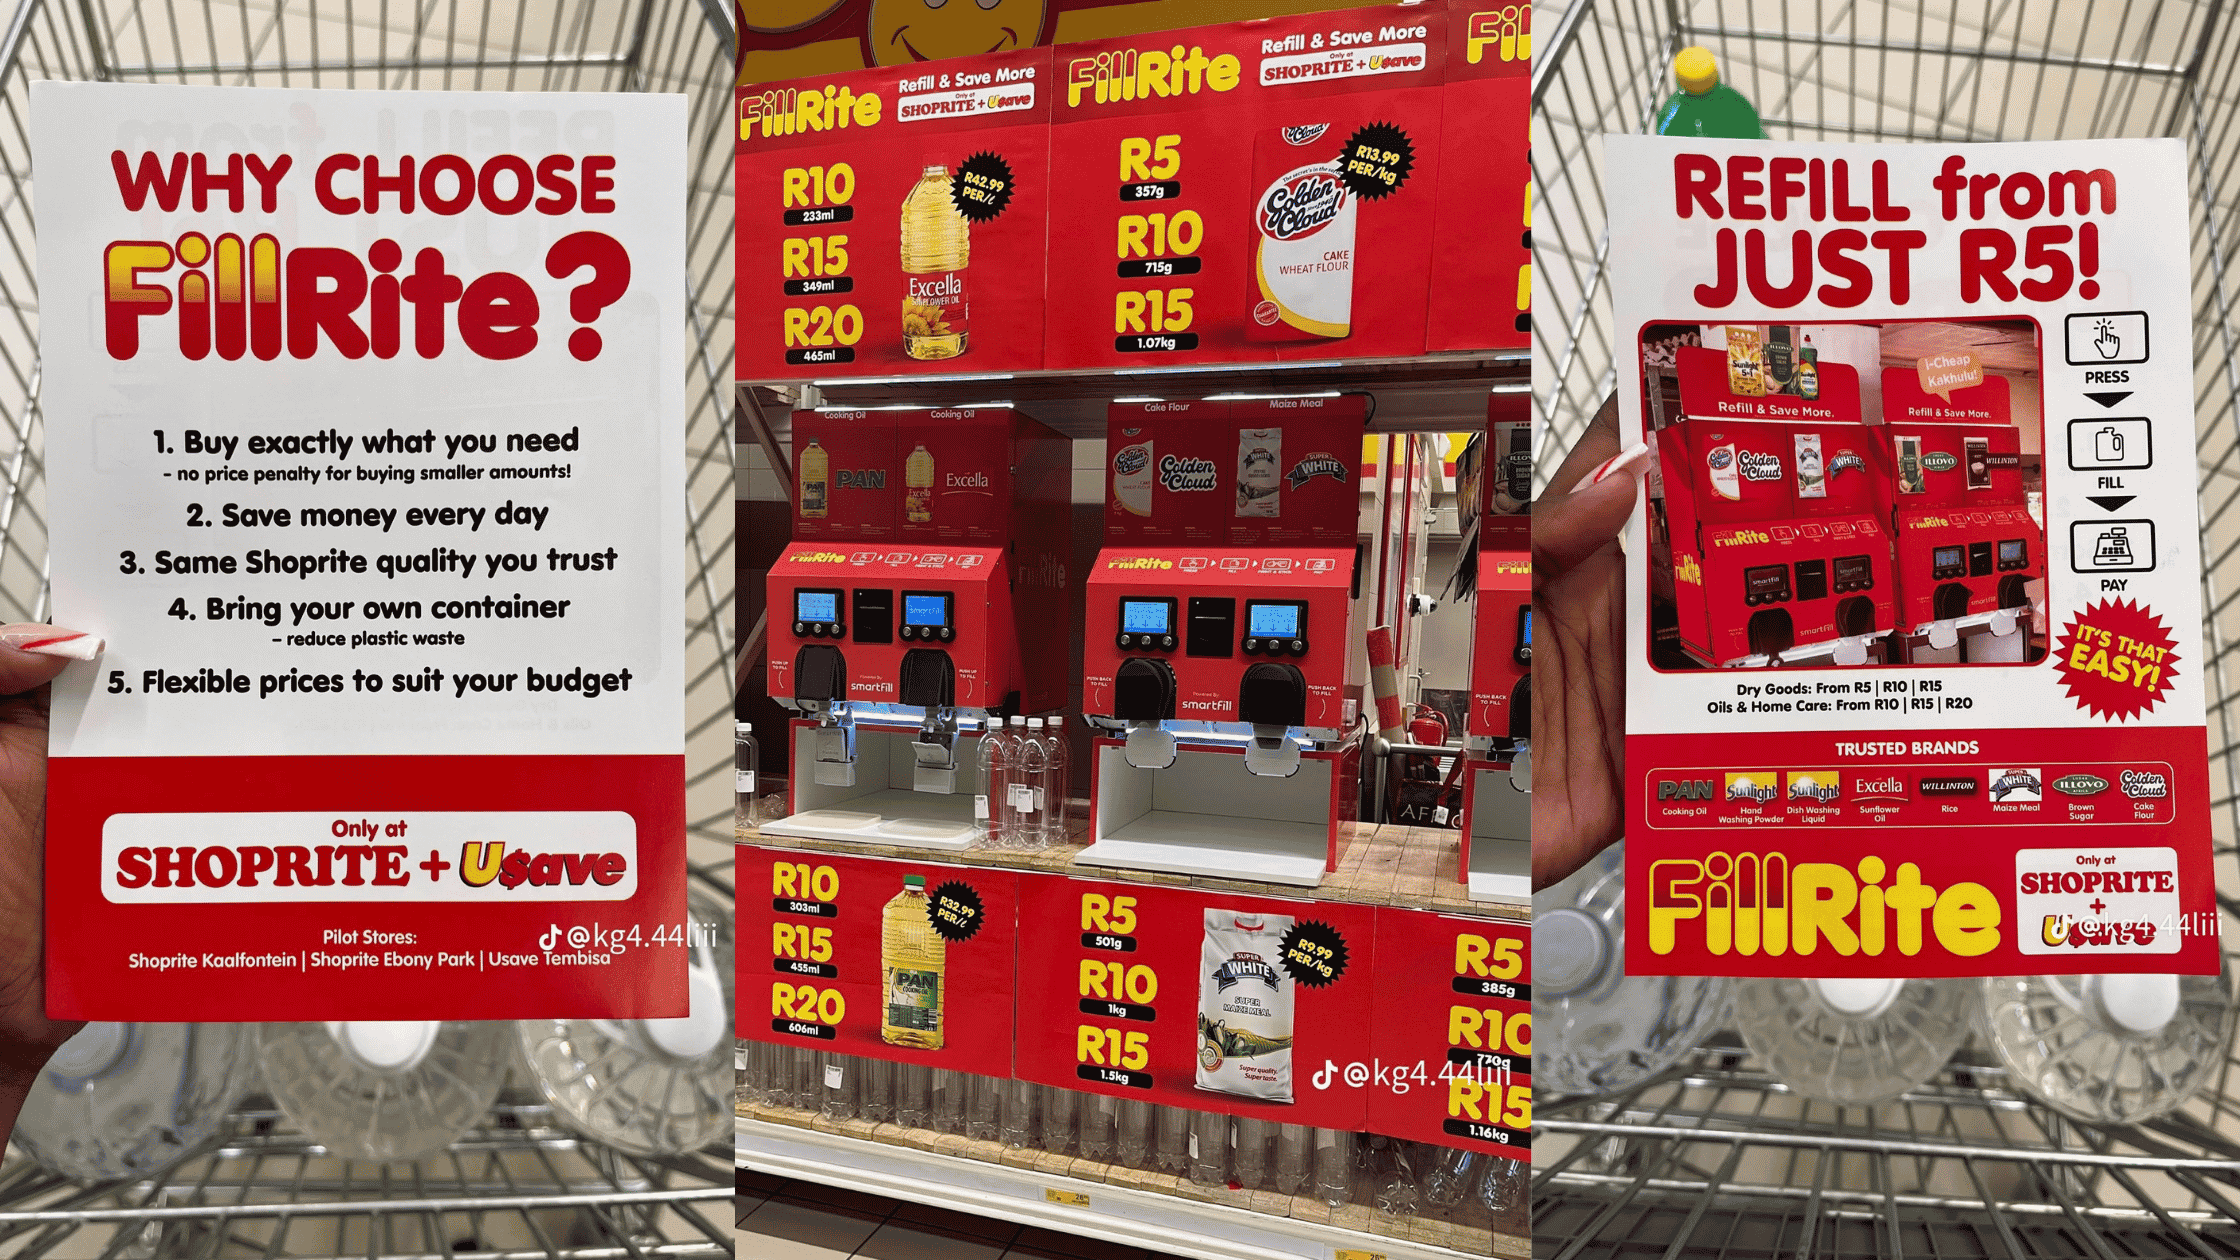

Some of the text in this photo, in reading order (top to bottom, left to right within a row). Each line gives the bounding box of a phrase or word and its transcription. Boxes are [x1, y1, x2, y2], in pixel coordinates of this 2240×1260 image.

[1262, 26, 1427, 54] Refill Save More
[1068, 45, 1240, 107] FillRite
[1265, 59, 1353, 81] SHOPRITE
[899, 67, 1035, 93] Refill Save More
[740, 85, 882, 140] FillRite
[902, 99, 975, 117] SHOPRITE
[1120, 135, 1181, 181] R5
[1352, 145, 1399, 169] R13.99
[1347, 160, 1396, 185] PER/kg
[111, 150, 615, 215] WHY CHOOSE
[784, 163, 855, 207] R10
[963, 172, 1004, 196] R42.99
[1136, 185, 1164, 198] 357g
[1674, 154, 2116, 221] REFILL from
[804, 209, 833, 221] 233ml
[784, 235, 848, 277] R15
[1324, 251, 1349, 261] CAKE
[1694, 222, 2100, 308] JUST R5!
[1280, 262, 1349, 275] WHEAT FLOUR
[803, 280, 834, 292] 349ml
[910, 273, 961, 297] Excella
[1116, 288, 1193, 333] R15
[785, 305, 863, 347] R20
[1138, 337, 1175, 350] 1.07kg
[804, 350, 835, 361] 465ml
[1928, 370, 1977, 387] Kakhulu!
[2086, 371, 2129, 383] PRESS
[931, 410, 975, 420] Cooking Oil
[1145, 403, 1189, 412] Cake Flour
[1719, 402, 1834, 417] Refill & Save More.
[185, 426, 578, 460] Buy exactly what you need
[178, 464, 570, 485] no price penalty for buying smaller amounts!
[836, 469, 885, 488] PAN
[946, 472, 989, 488] Excella
[2098, 477, 2124, 488] FILL
[156, 547, 618, 580] Same Shoprite quality you trust
[2101, 579, 2127, 591] PAY
[287, 630, 464, 649] reduce plastic waste
[2073, 624, 2167, 667] IT'S THAT
[2069, 643, 2160, 692] EASY!
[143, 667, 632, 699] Flexible prices to suit your budget
[851, 682, 893, 692] smartfill
[1182, 701, 1232, 711] smartfill
[1708, 697, 1972, 713] Oils & Home Care: From R10 R15 R20
[1836, 741, 1979, 755] TRUSTED BRANDS
[2003, 775, 2032, 785] WHITE
[1659, 777, 2103, 803] PAN Sunlight Sunlight Excella WILLINTON ILLOVO
[1663, 808, 1693, 816] Cooking
[2070, 813, 2093, 821] Sugar
[332, 819, 407, 842] Only at
[117, 845, 410, 888] SHOPRITE
[2076, 855, 2116, 867] Only at
[773, 862, 839, 901] R10
[2021, 871, 2174, 894] SHOPRITE
[790, 902, 819, 913] 303ml
[939, 896, 975, 918] R32.99
[1648, 851, 2001, 956] FillRite
[1082, 894, 1136, 934] R5
[324, 929, 416, 944] Pilot Stores:
[1096, 936, 1121, 950] 501g
[1236, 953, 1259, 961] SUPER
[1298, 939, 1333, 959] R9.99
[1455, 934, 1523, 979] R5
[130, 950, 610, 971] Shoprite Kaalfontein Shoprite Ebony Park Usave Tembisa
[1227, 961, 1270, 977] WHITE
[1288, 949, 1333, 977] PER/kg
[898, 973, 934, 989] PAN
[1080, 960, 1157, 1004] R10
[1482, 982, 1515, 998] 385g
[772, 983, 845, 1024] R20
[1109, 1004, 1126, 1017] 1kg
[1223, 1004, 1271, 1017] MAIZE MEAL
[1234, 996, 1260, 1006] SUPER
[789, 1023, 818, 1035] 606ml
[1449, 1006, 1531, 1055] R10
[1078, 1025, 1148, 1070] R15
[1101, 1070, 1128, 1085] 1.5kg
[1470, 1125, 1508, 1143] 1.16kg
